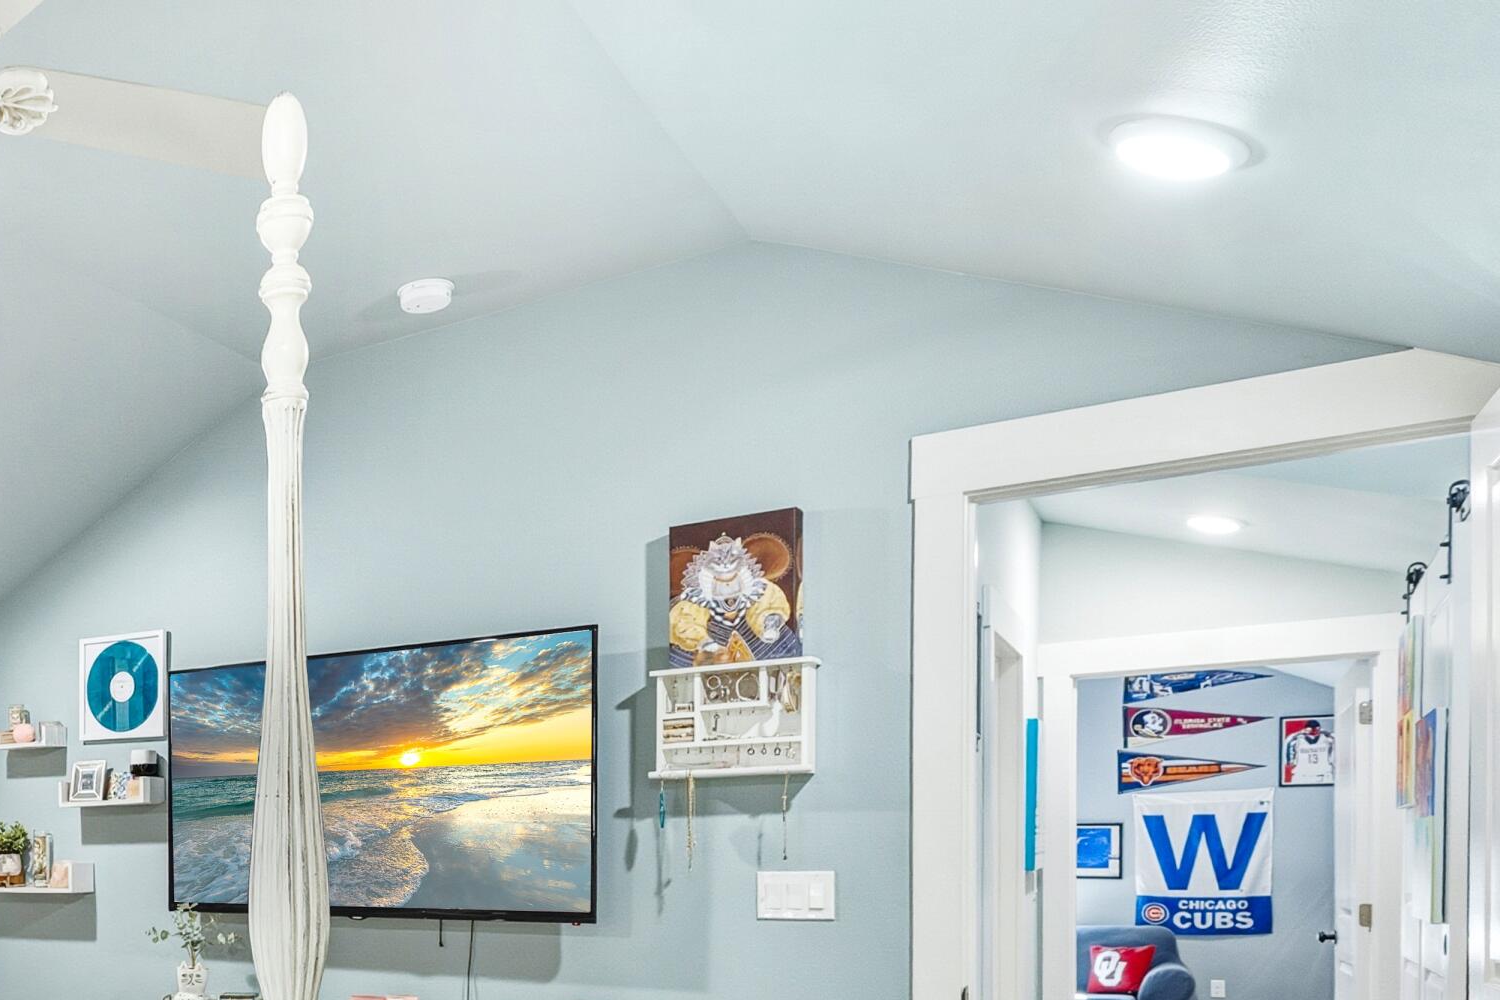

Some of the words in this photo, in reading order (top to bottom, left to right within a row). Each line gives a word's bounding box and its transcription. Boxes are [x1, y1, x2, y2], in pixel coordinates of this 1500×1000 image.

[1142, 811, 1268, 891] W
[1178, 899, 1249, 910] CHICAGO
[1172, 911, 1254, 929] CUBS
[1093, 950, 1127, 987] OU
